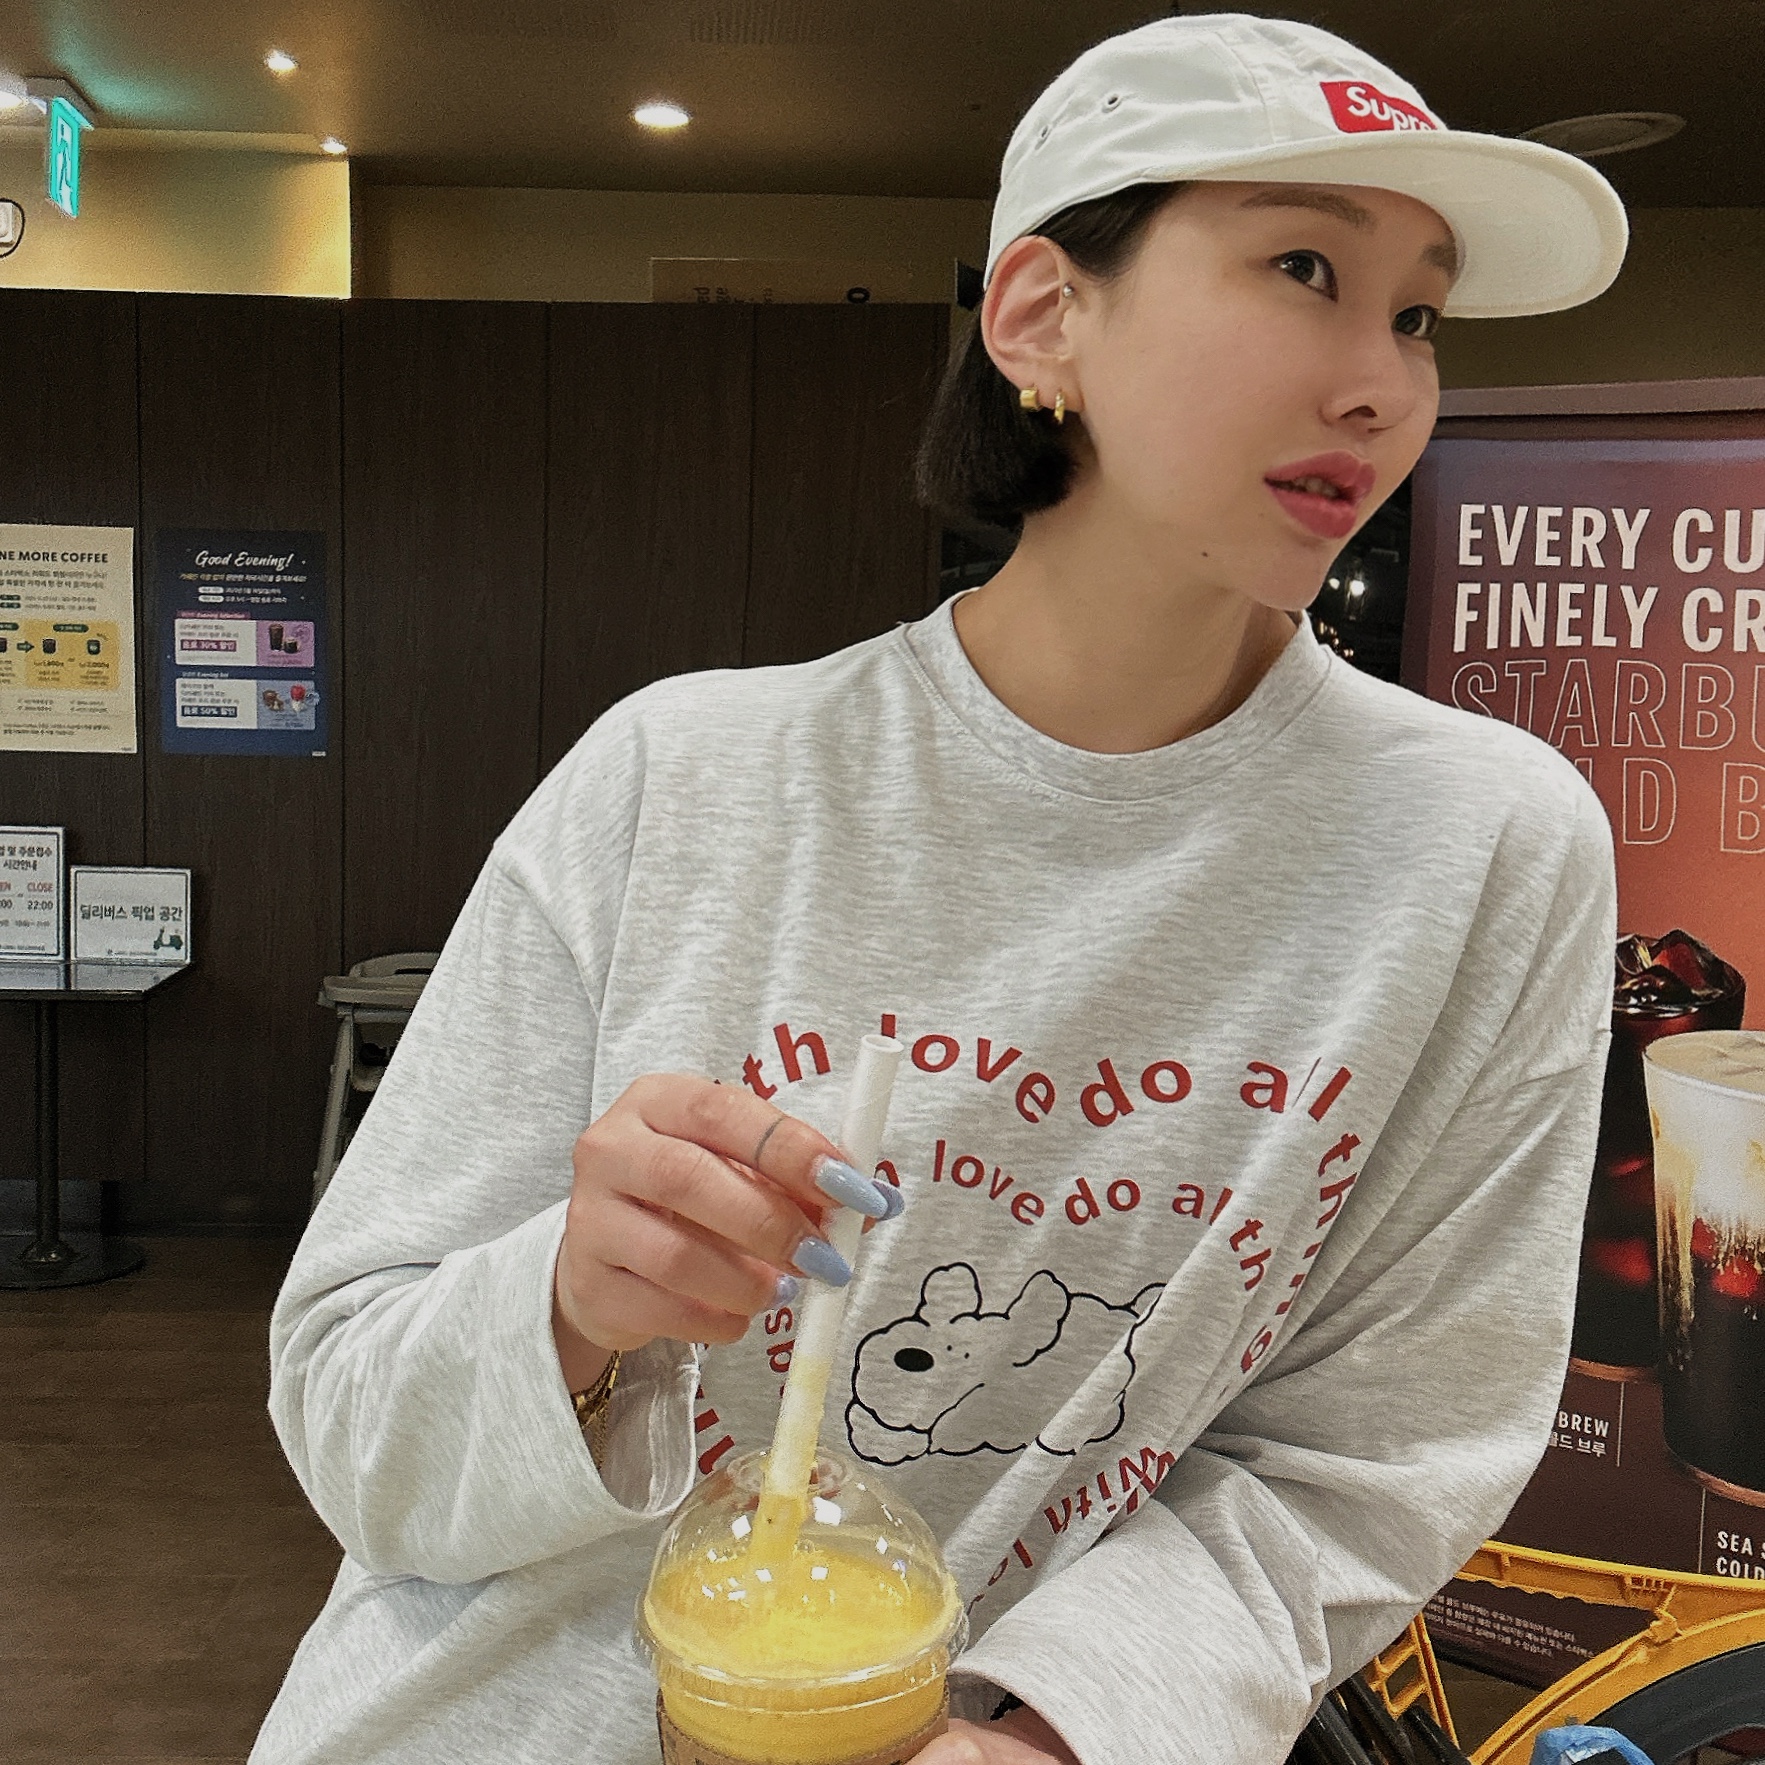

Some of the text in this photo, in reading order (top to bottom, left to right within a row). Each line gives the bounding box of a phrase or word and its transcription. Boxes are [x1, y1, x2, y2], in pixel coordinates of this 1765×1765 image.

[1458, 503, 1765, 574] EVERY CU
[18, 551, 58, 562] MORE
[61, 552, 108, 563] COFFEE
[195, 550, 294, 572] Good Evening!
[1453, 582, 1765, 653] FINELY CR
[27, 881, 54, 893] CLOSE
[27, 899, 54, 911] 22:00
[131, 905, 155, 921] 픽업
[159, 905, 183, 922] 공간
[1079, 1057, 1192, 1128] do
[933, 1139, 1045, 1226] love
[1064, 1176, 1142, 1226] do
[1558, 1410, 1610, 1438] BREW
[1578, 1437, 1607, 1458] 브루
[1717, 1530, 1754, 1557] SEA
